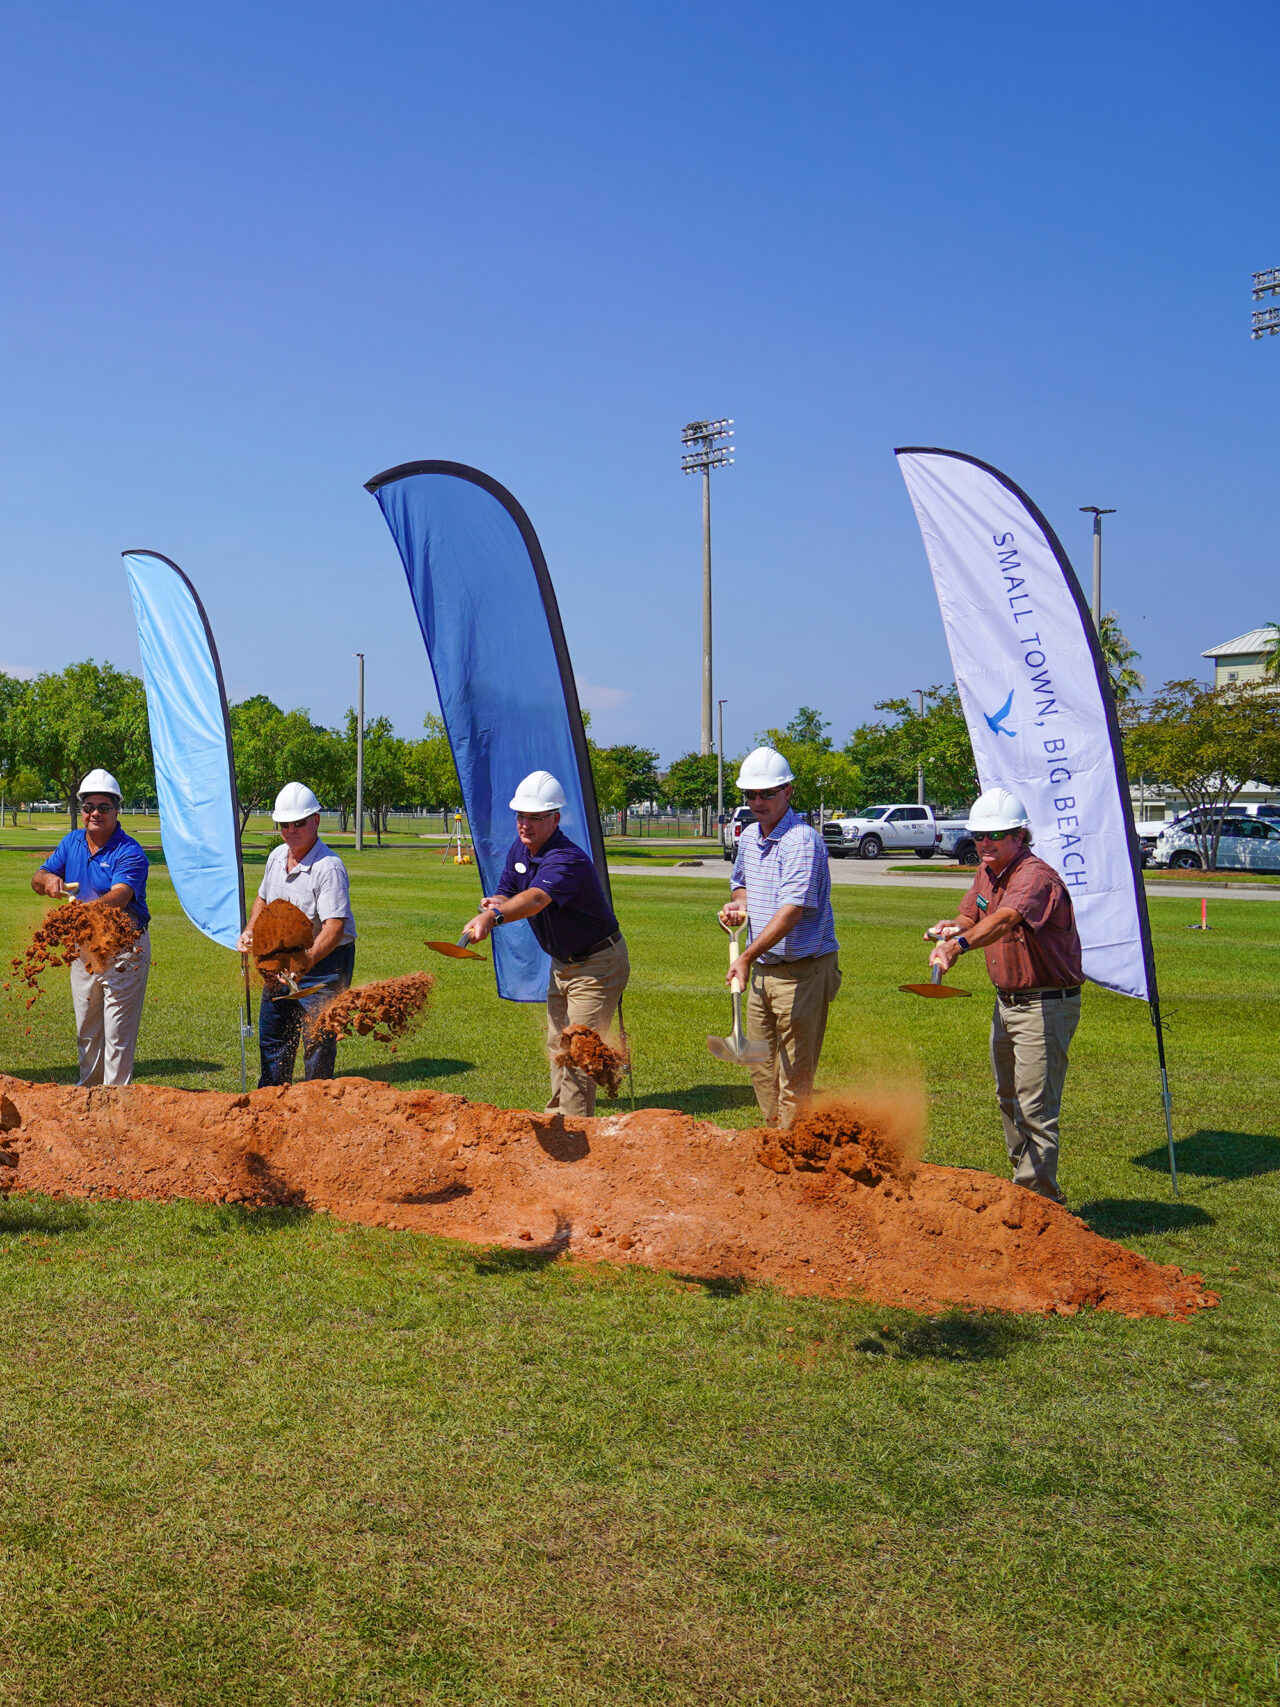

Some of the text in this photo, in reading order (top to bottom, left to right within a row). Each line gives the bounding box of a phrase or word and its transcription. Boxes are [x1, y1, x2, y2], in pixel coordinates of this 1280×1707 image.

[993, 532, 1088, 887] SMALL TOWN, BIG BEACH
